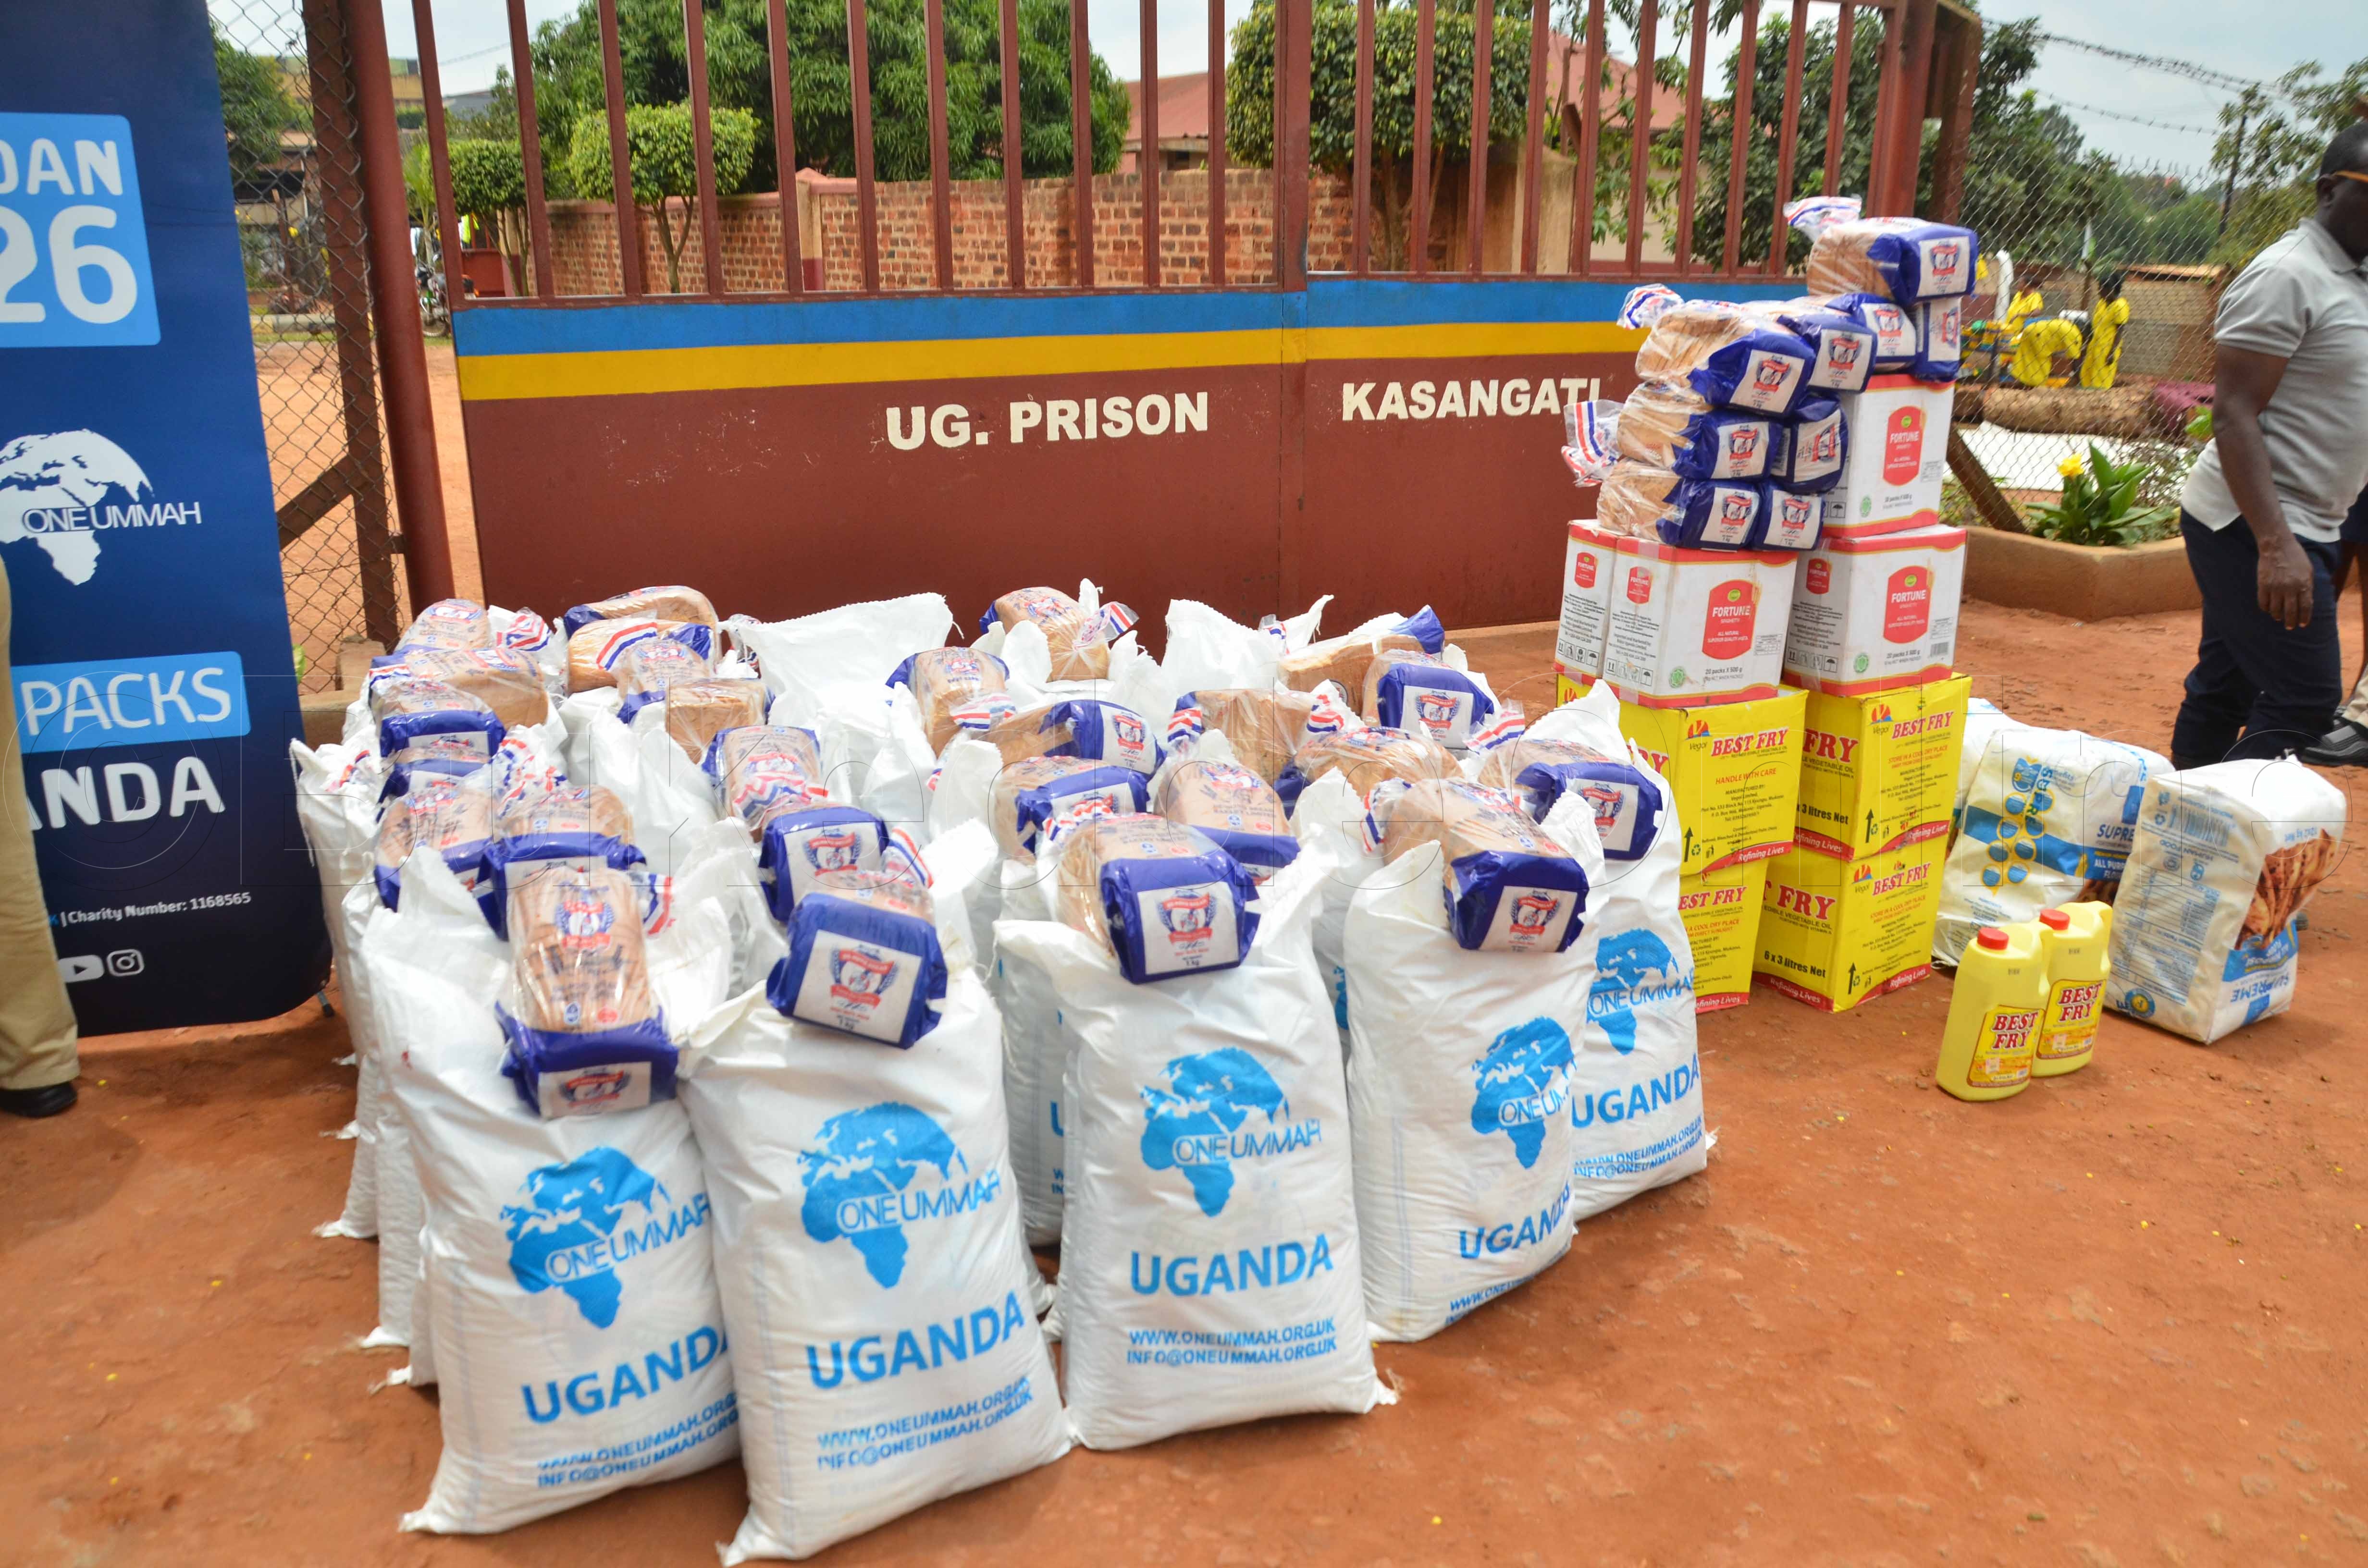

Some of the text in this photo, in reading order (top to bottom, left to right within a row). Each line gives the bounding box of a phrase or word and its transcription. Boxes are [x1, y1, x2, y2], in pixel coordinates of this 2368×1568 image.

[1342, 377, 1601, 423] KASANGATI
[887, 392, 1209, 450] UG. PRISON
[1890, 431, 1919, 444] FORTUNE
[1891, 589, 1926, 603] FORTUNE
[1712, 606, 1751, 617] FORTUNE
[21, 667, 232, 736] PACKS
[1891, 718, 1926, 740] BEST
[1926, 711, 1954, 732] FRY
[1711, 726, 1789, 757] BEST FRY
[1802, 727, 1859, 764] FRY
[1715, 768, 1776, 784] HANDLE WITH CARE
[1808, 758, 1843, 772] VEGETABLE
[26, 756, 225, 831] NDA
[1726, 785, 1760, 795] MANUFACTURED
[1802, 805, 1849, 825] 3 litres Net
[1738, 845, 1785, 862] Refining Lives
[1795, 833, 1843, 854] efining Lives
[1872, 862, 1931, 896] BEST FRY
[68, 891, 251, 925] Charity Number: 1168565
[1677, 886, 1747, 911] EST FRY
[1776, 883, 1836, 920] FRY
[1694, 923, 1709, 931] COOL
[1709, 920, 1721, 929] DRY
[1722, 918, 1739, 926] PLACE
[1764, 905, 1784, 917] EDIBLE
[1785, 910, 1819, 927] VEGETABLE
[1764, 950, 1826, 978] 6 x 3 litres Net
[1769, 978, 1821, 1004] Refining Lives
[1889, 968, 1926, 989] Refining Lives
[2230, 972, 2289, 1003] SUPREME
[1696, 995, 1741, 1010] efining Lives
[2057, 982, 2103, 1005] BEST
[1991, 1011, 2039, 1032] BEST
[2059, 1001, 2095, 1023] FRY
[1991, 1030, 2031, 1050] FRY
[1572, 1061, 1699, 1128] UGANDA
[1130, 1233, 1334, 1298] UGANDA
[807, 1289, 1025, 1391] UGANDA
[1130, 1317, 1336, 1347] WWW.ONEUMMAH.ORG.UK
[1127, 1336, 1337, 1367] INFO@ONEUMMAH.ORG.UK
[818, 1375, 1031, 1446] WWW.ONEUMMAH.ORG.UK
